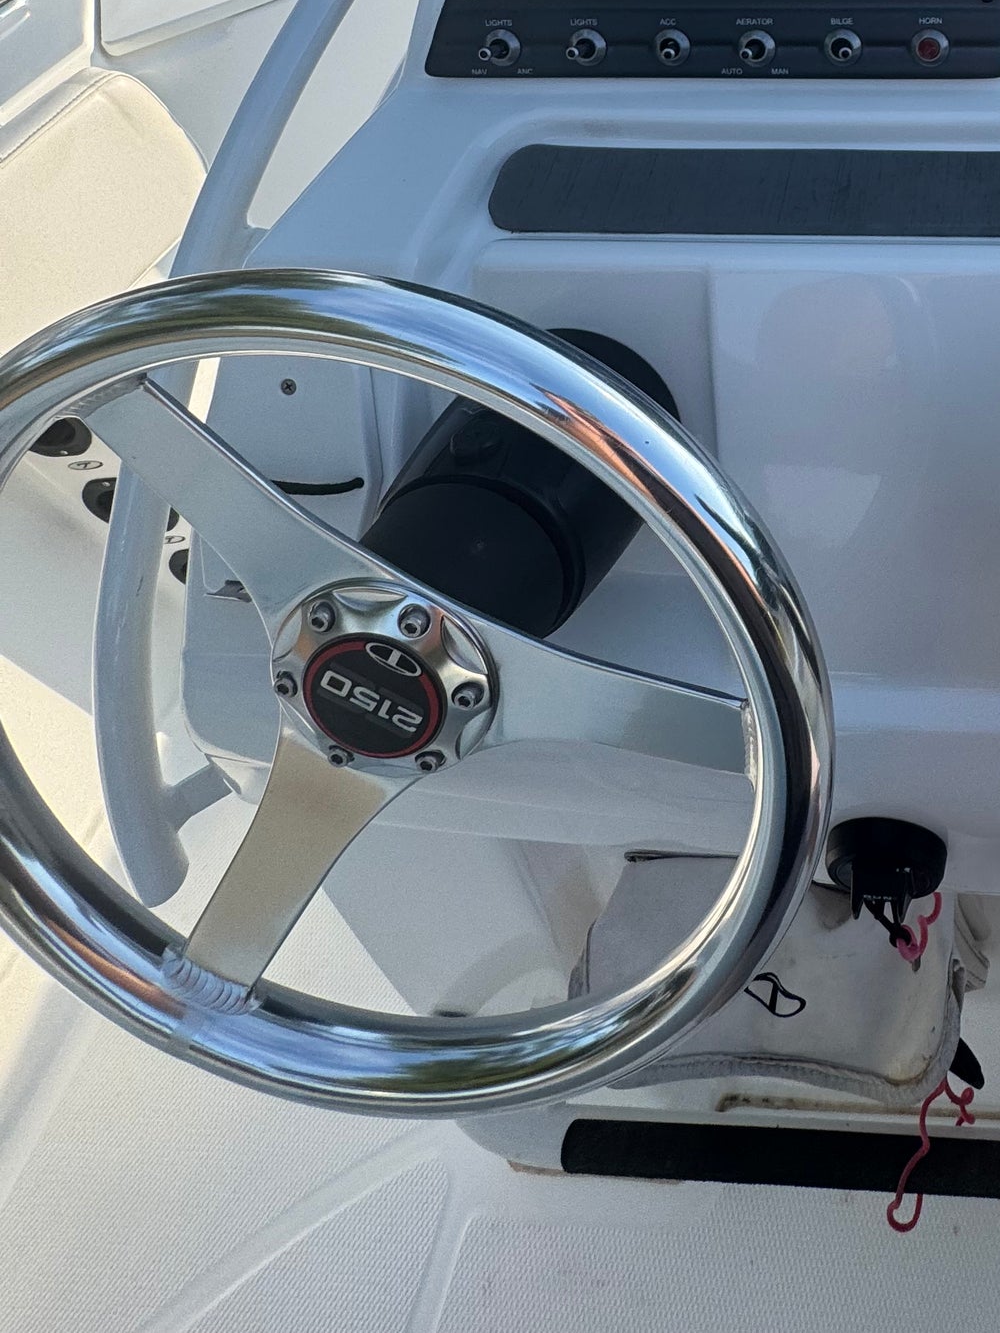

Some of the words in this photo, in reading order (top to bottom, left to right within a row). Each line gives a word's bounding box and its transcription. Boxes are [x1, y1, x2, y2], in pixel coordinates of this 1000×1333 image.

[485, 19, 512, 27] LIGHTS
[570, 18, 597, 26] LIGHTS
[660, 18, 676, 26] ACC
[831, 17, 853, 25] BILGE
[919, 17, 942, 25] HORN
[320, 670, 423, 732] 2150
